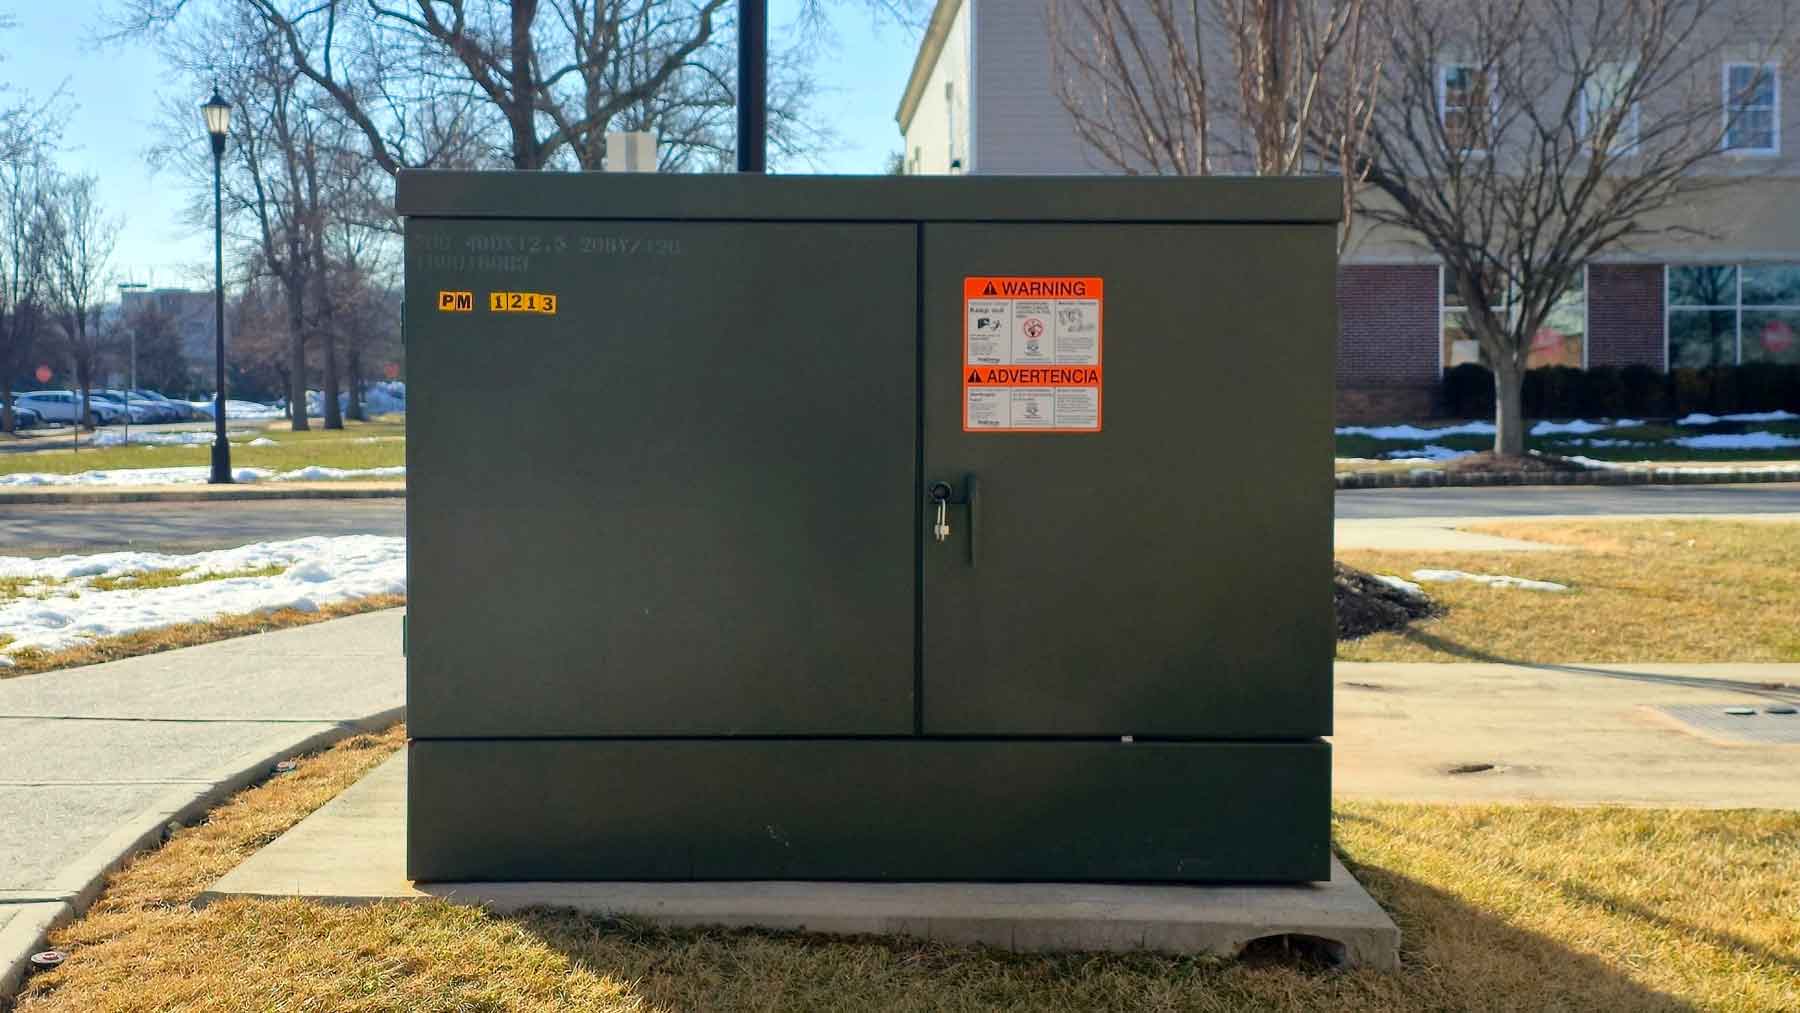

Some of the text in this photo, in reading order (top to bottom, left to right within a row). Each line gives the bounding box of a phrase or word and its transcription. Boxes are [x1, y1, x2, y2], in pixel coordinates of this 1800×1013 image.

[1002, 281, 1086, 296] WARNING
[441, 293, 554, 312] PM 1213
[987, 369, 1098, 384] ADVERTENCIA
